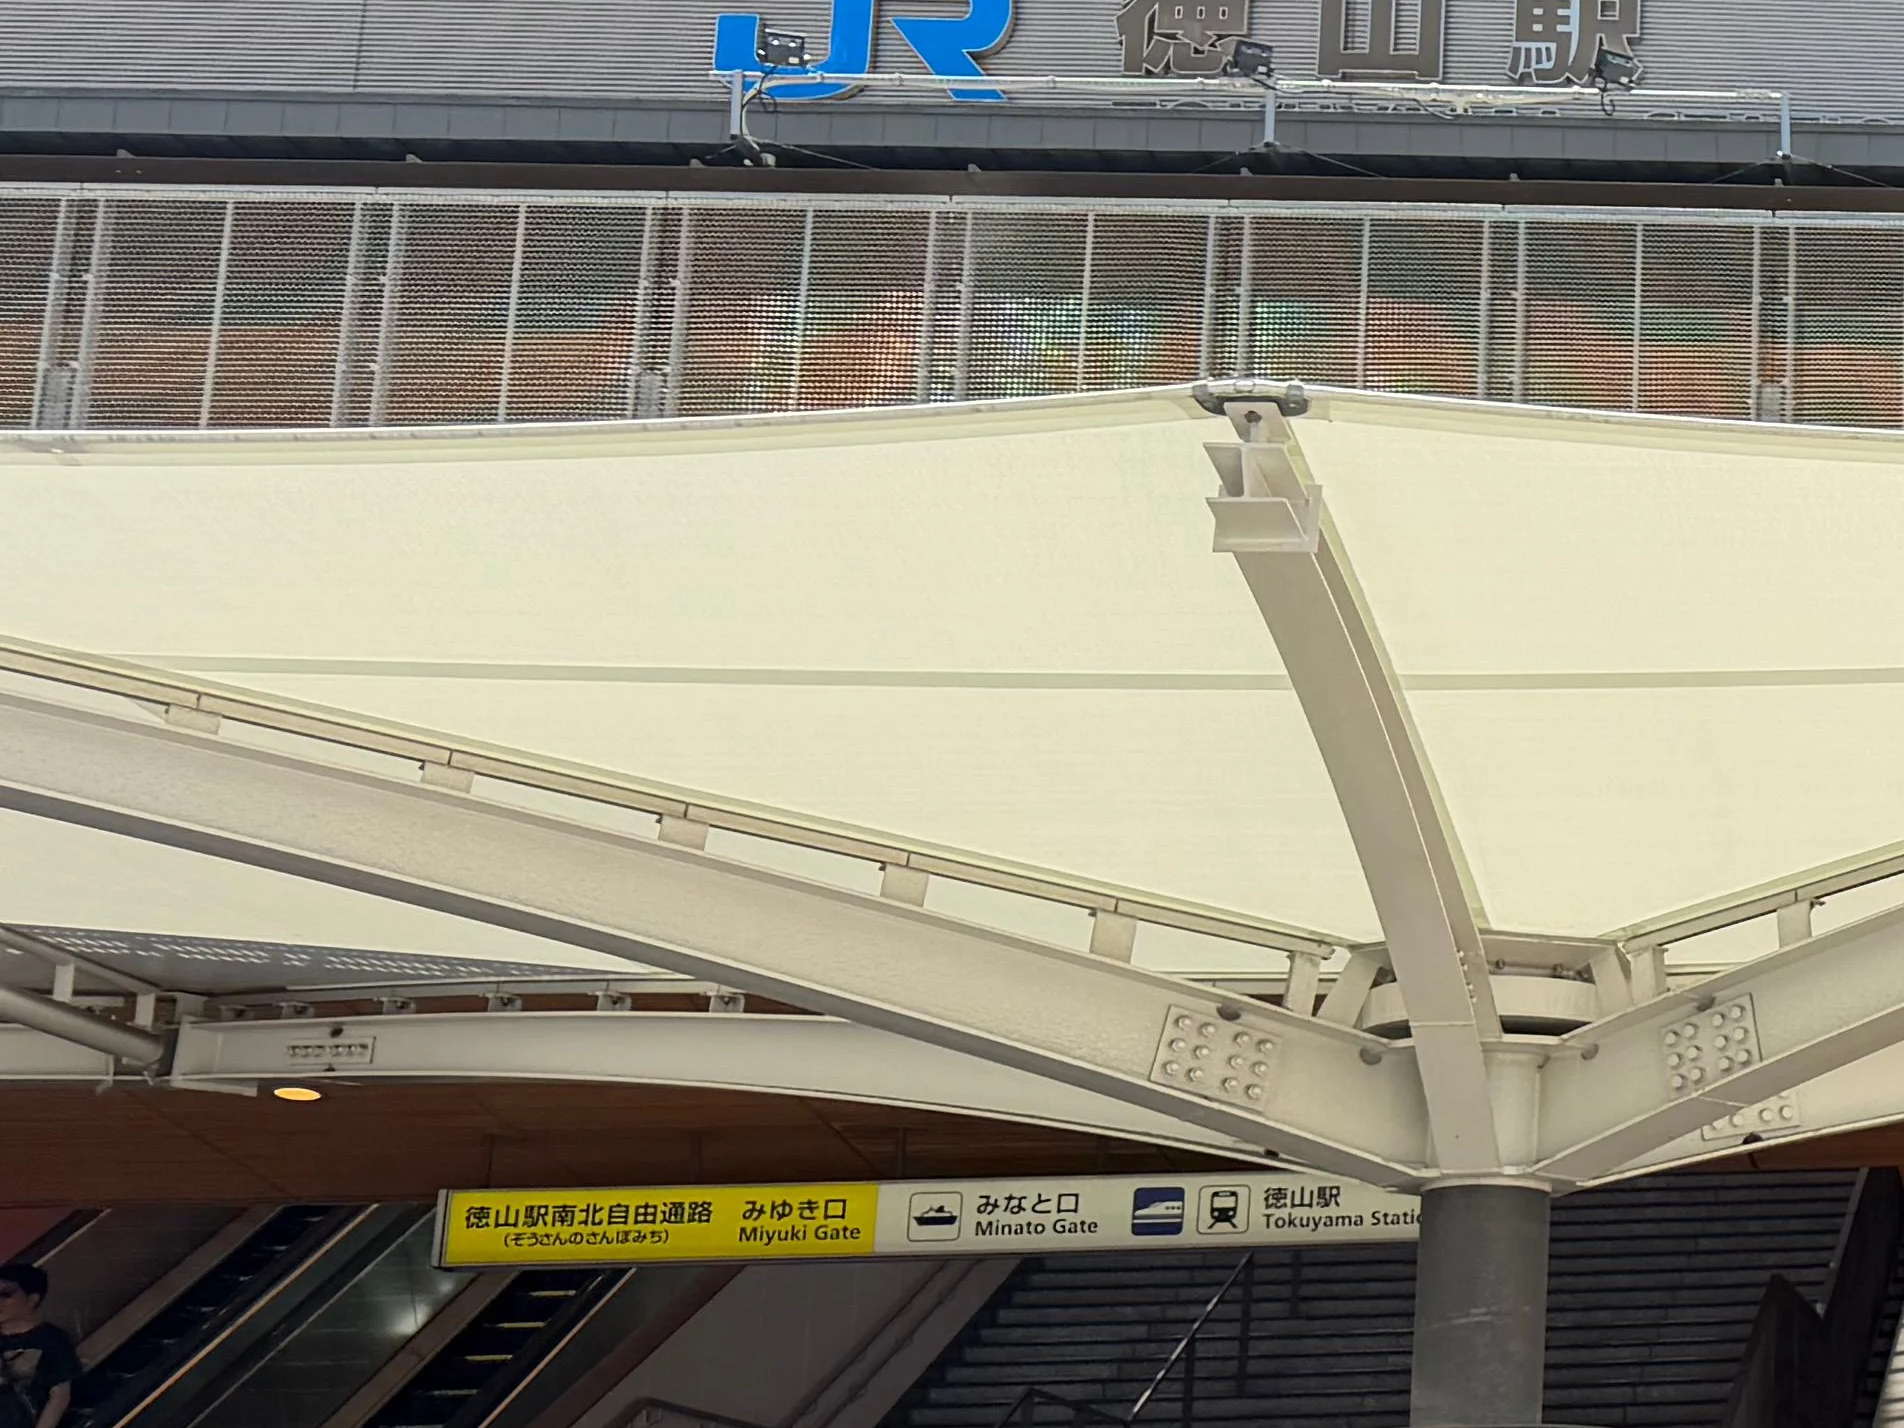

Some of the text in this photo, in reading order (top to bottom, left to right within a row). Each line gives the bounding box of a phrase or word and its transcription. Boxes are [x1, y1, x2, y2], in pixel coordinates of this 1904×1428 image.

[976, 1192, 1079, 1215] みなと口
[1263, 1185, 1340, 1209] 徳山駅
[465, 1201, 713, 1229] 徳山駅南北自由通路
[742, 1198, 847, 1221] みゆき口
[975, 1218, 1098, 1236] Minato Gate
[1263, 1212, 1364, 1232] Tokuyama
[738, 1224, 861, 1246] Miyuki Gate
